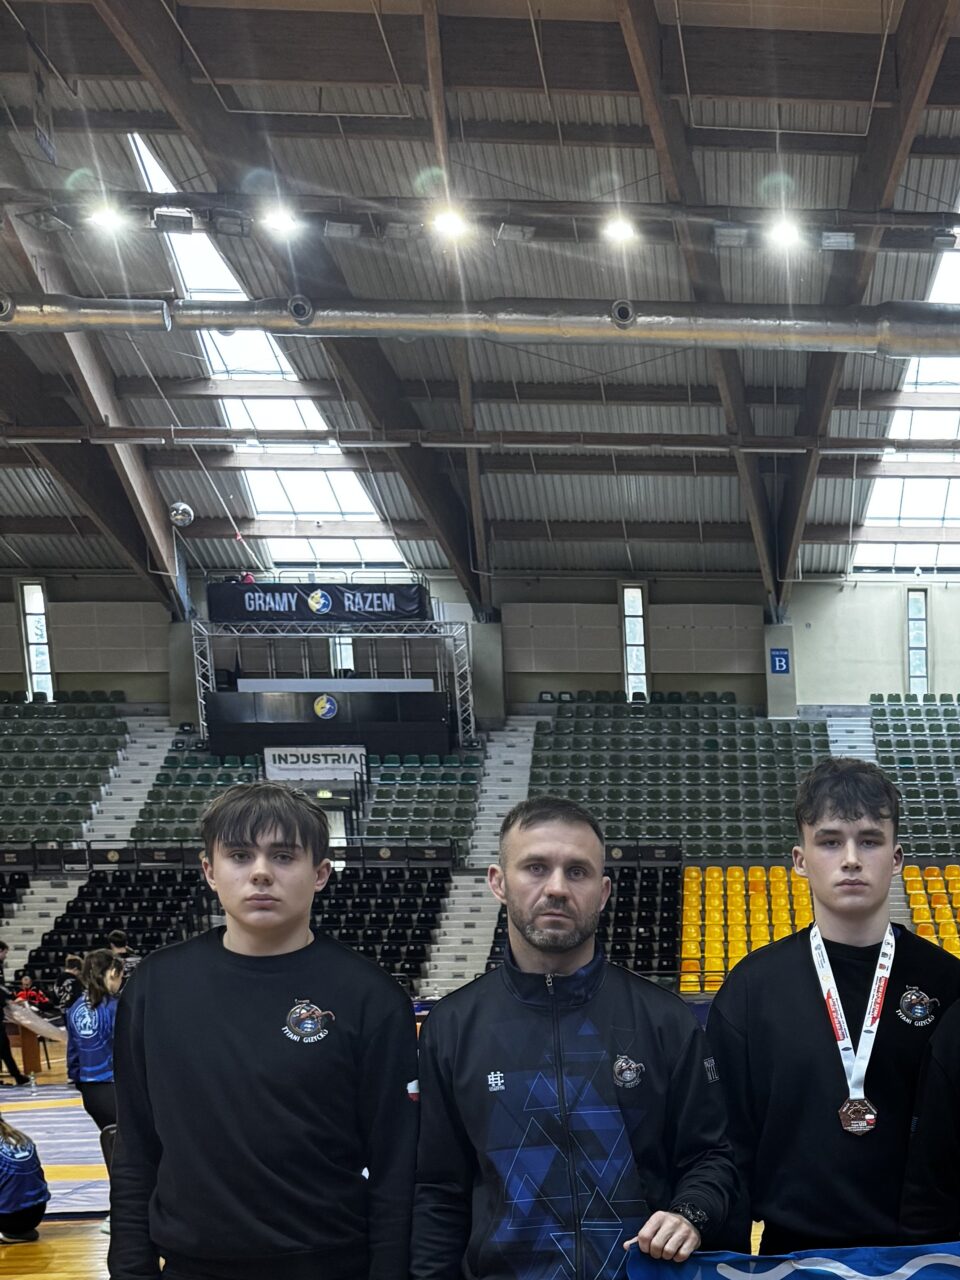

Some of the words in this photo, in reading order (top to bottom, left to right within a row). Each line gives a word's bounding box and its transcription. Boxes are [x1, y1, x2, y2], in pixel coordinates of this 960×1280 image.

[244, 592, 298, 612] GRAMY
[343, 592, 396, 612] RAZEM
[775, 657, 787, 671] B
[272, 753, 359, 765] INDUSTRIA
